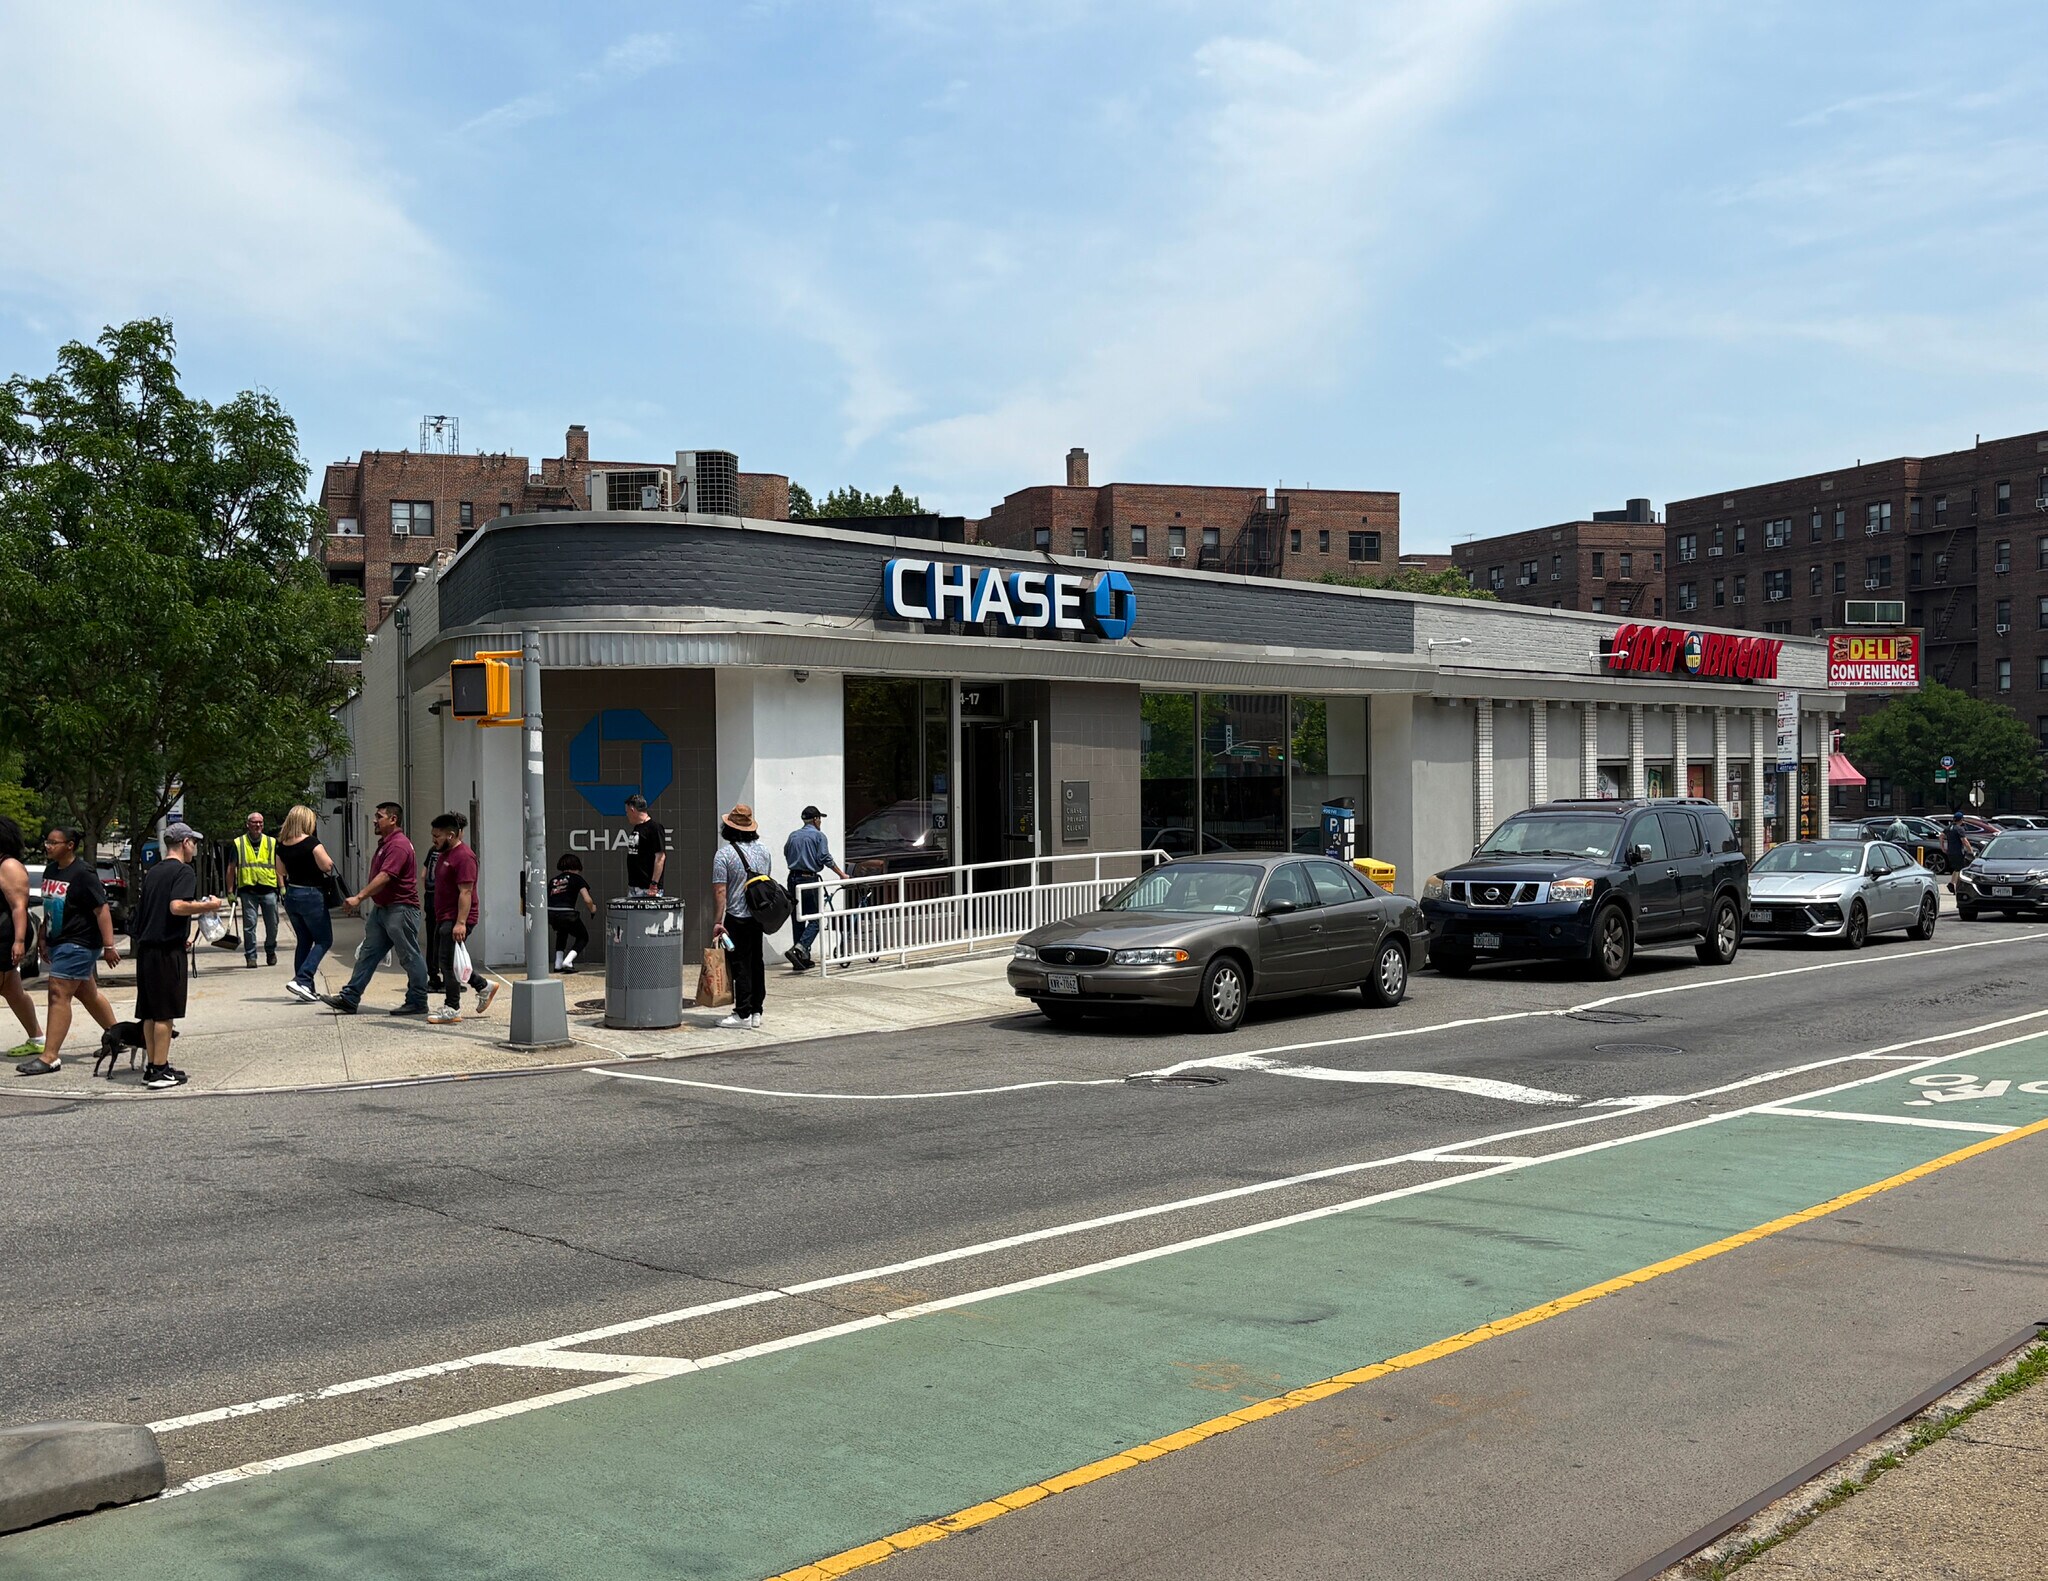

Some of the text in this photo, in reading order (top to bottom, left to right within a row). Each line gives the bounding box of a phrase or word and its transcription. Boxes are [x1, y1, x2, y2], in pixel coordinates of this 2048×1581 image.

[890, 558, 1086, 630] CHASE
[1850, 639, 1896, 660] DELI
[1830, 664, 1916, 680] CONVENIENCE
[569, 829, 674, 851] CHAE
